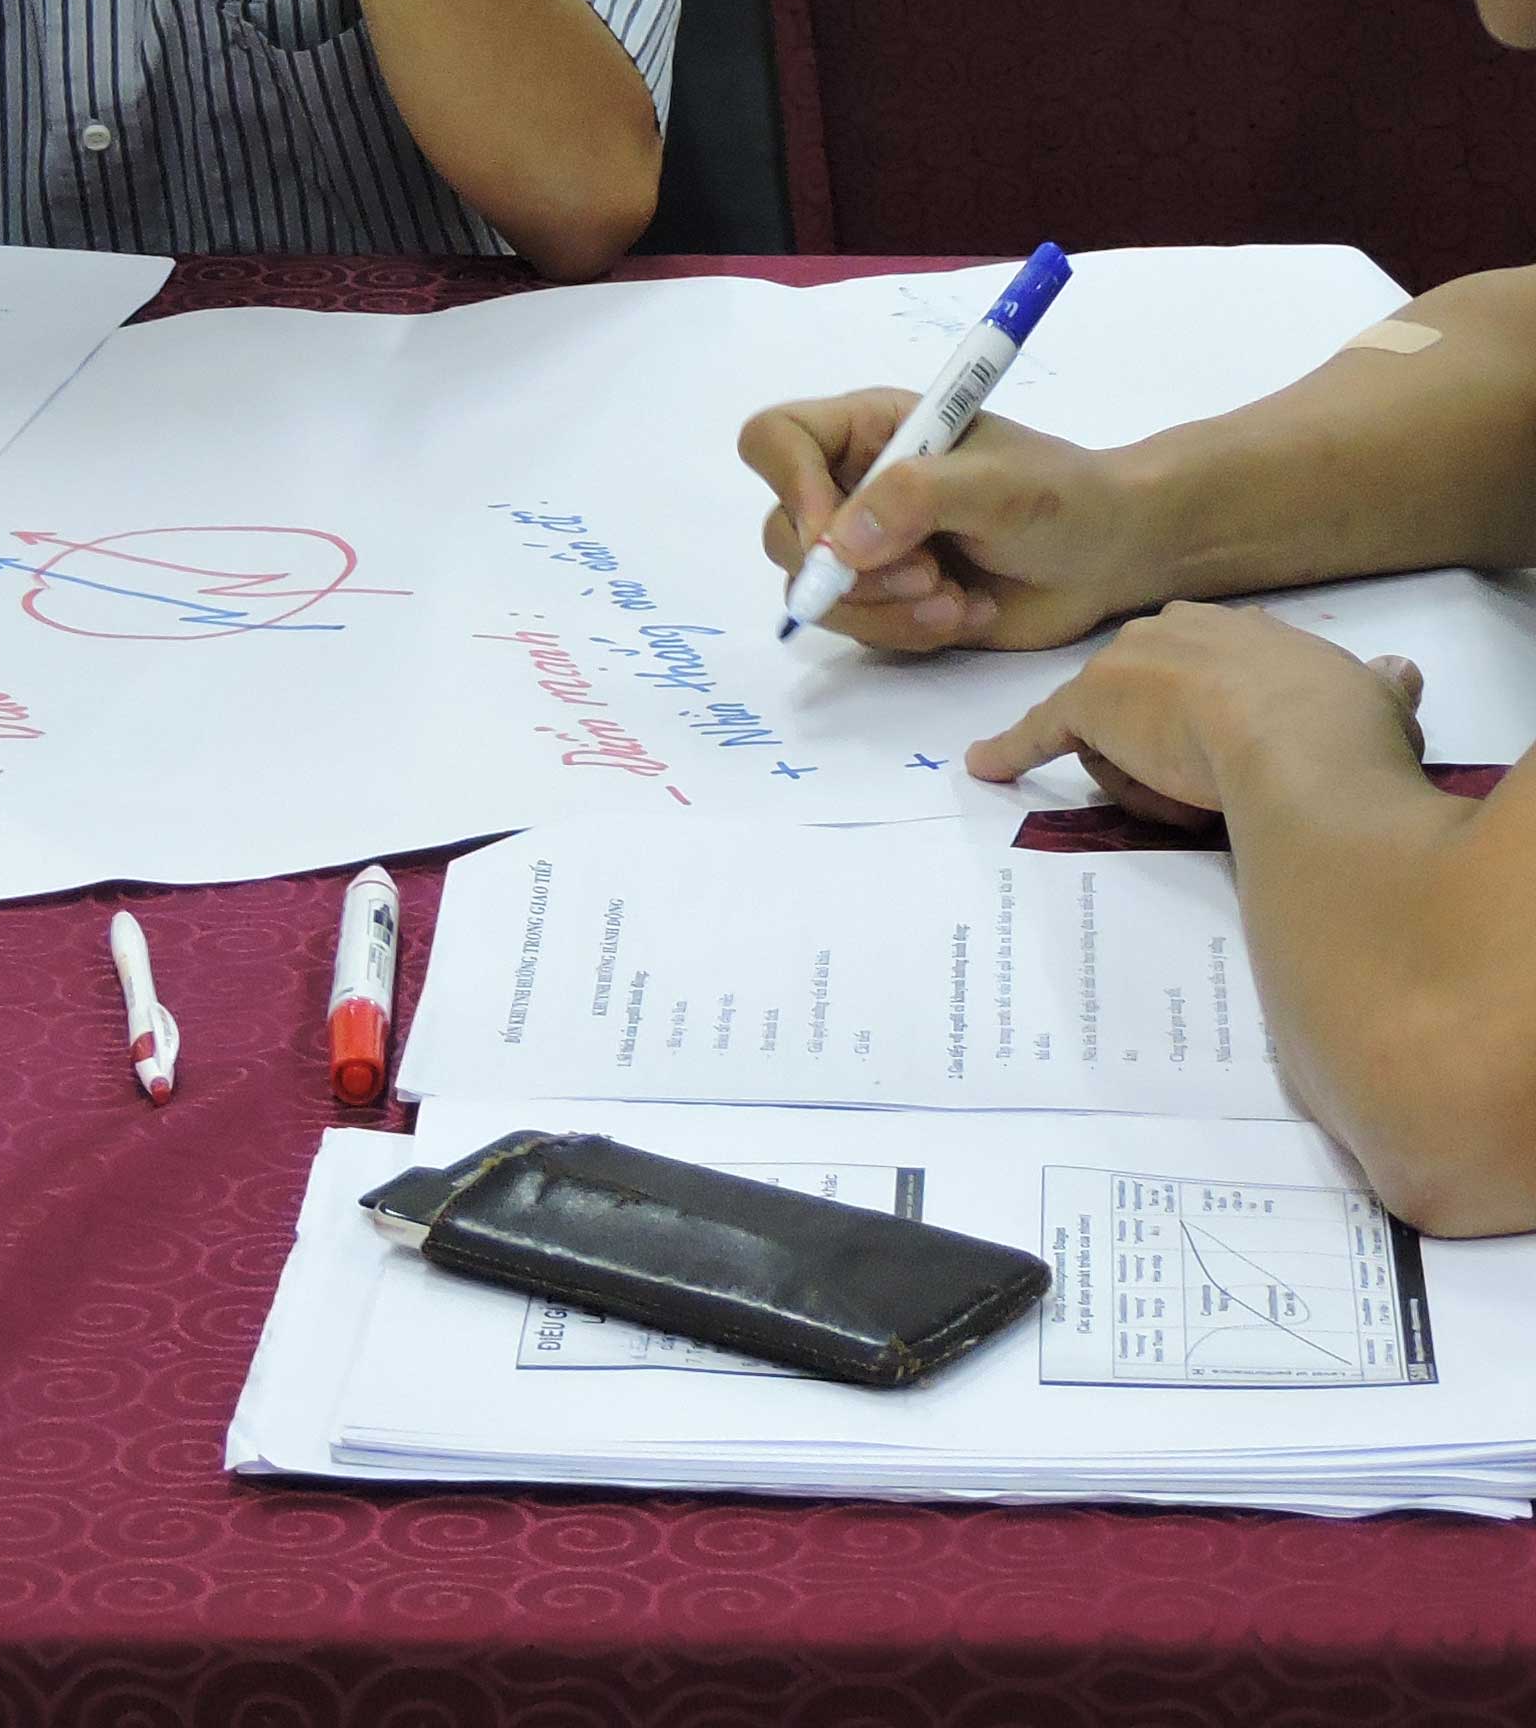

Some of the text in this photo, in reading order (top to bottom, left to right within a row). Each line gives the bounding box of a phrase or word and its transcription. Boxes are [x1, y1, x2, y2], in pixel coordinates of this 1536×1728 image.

[528, 860, 553, 882] TIẾP
[529, 886, 550, 914] GIAO
[522, 917, 544, 953] TRONG
[820, 1174, 839, 1198] khác
